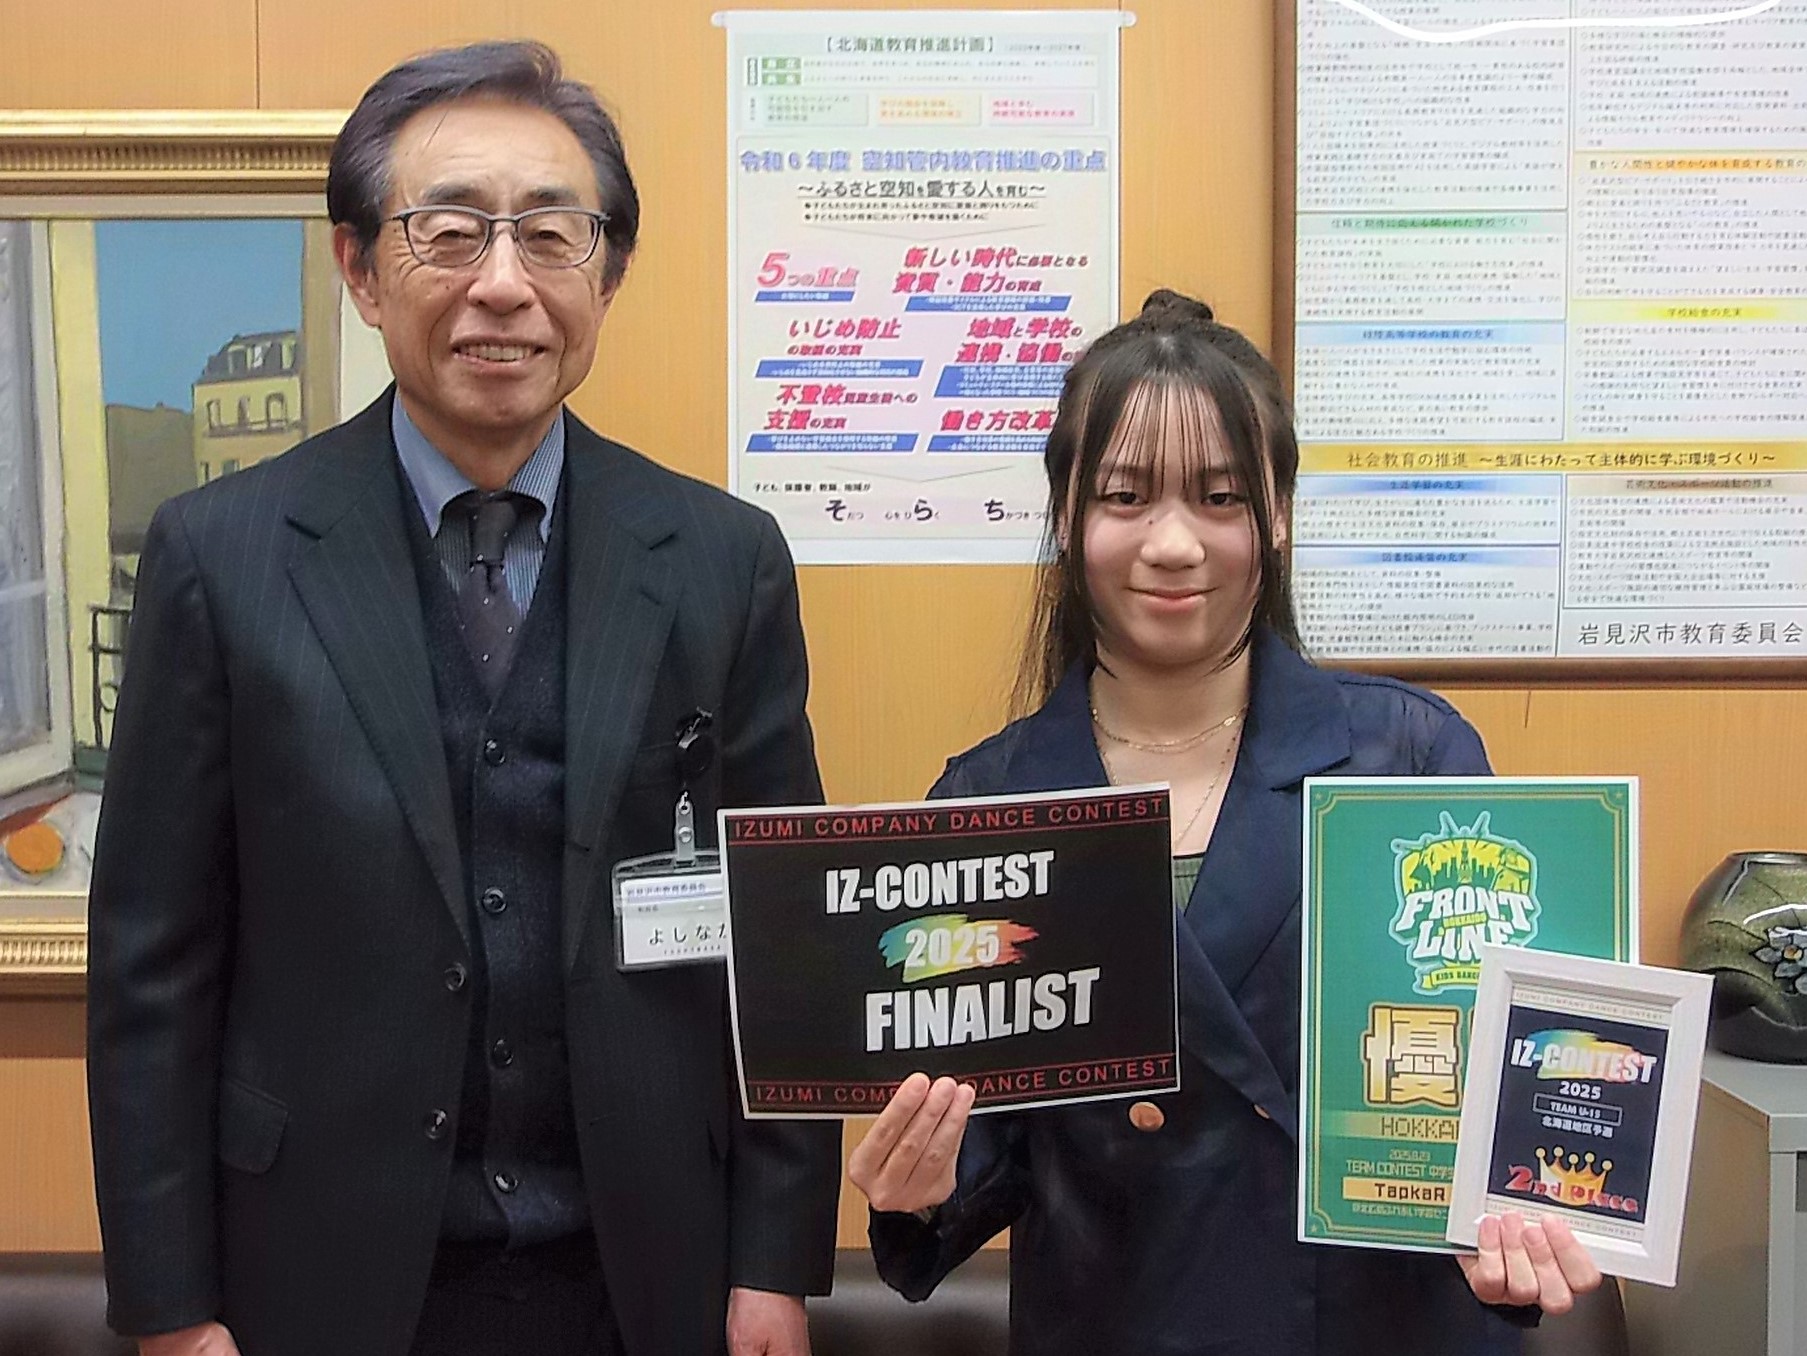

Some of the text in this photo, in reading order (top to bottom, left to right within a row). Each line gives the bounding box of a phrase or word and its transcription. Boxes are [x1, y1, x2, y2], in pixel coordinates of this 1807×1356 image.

[788, 317, 903, 340] いじめ防止
[1348, 451, 1469, 468] 社会教育の推進
[1578, 621, 1803, 646] 岩見沢市教育委員会
[735, 797, 1163, 838] IZUMI COMPANY DANCE CONTEST
[826, 850, 1055, 914] IZ-CONTEST
[1395, 885, 1535, 932] FRONT
[903, 927, 1001, 968] 2025
[1413, 918, 1515, 961] LINE
[865, 967, 1101, 1053] FINALIST
[756, 1086, 822, 1102] IZUMI
[1058, 1058, 1171, 1087] CONTEST
[1510, 1038, 1657, 1084] IZ-CONTEST
[1559, 1080, 1602, 1100] 2025
[1504, 1164, 1562, 1198] 2nd
[1569, 1184, 1639, 1213] Place
